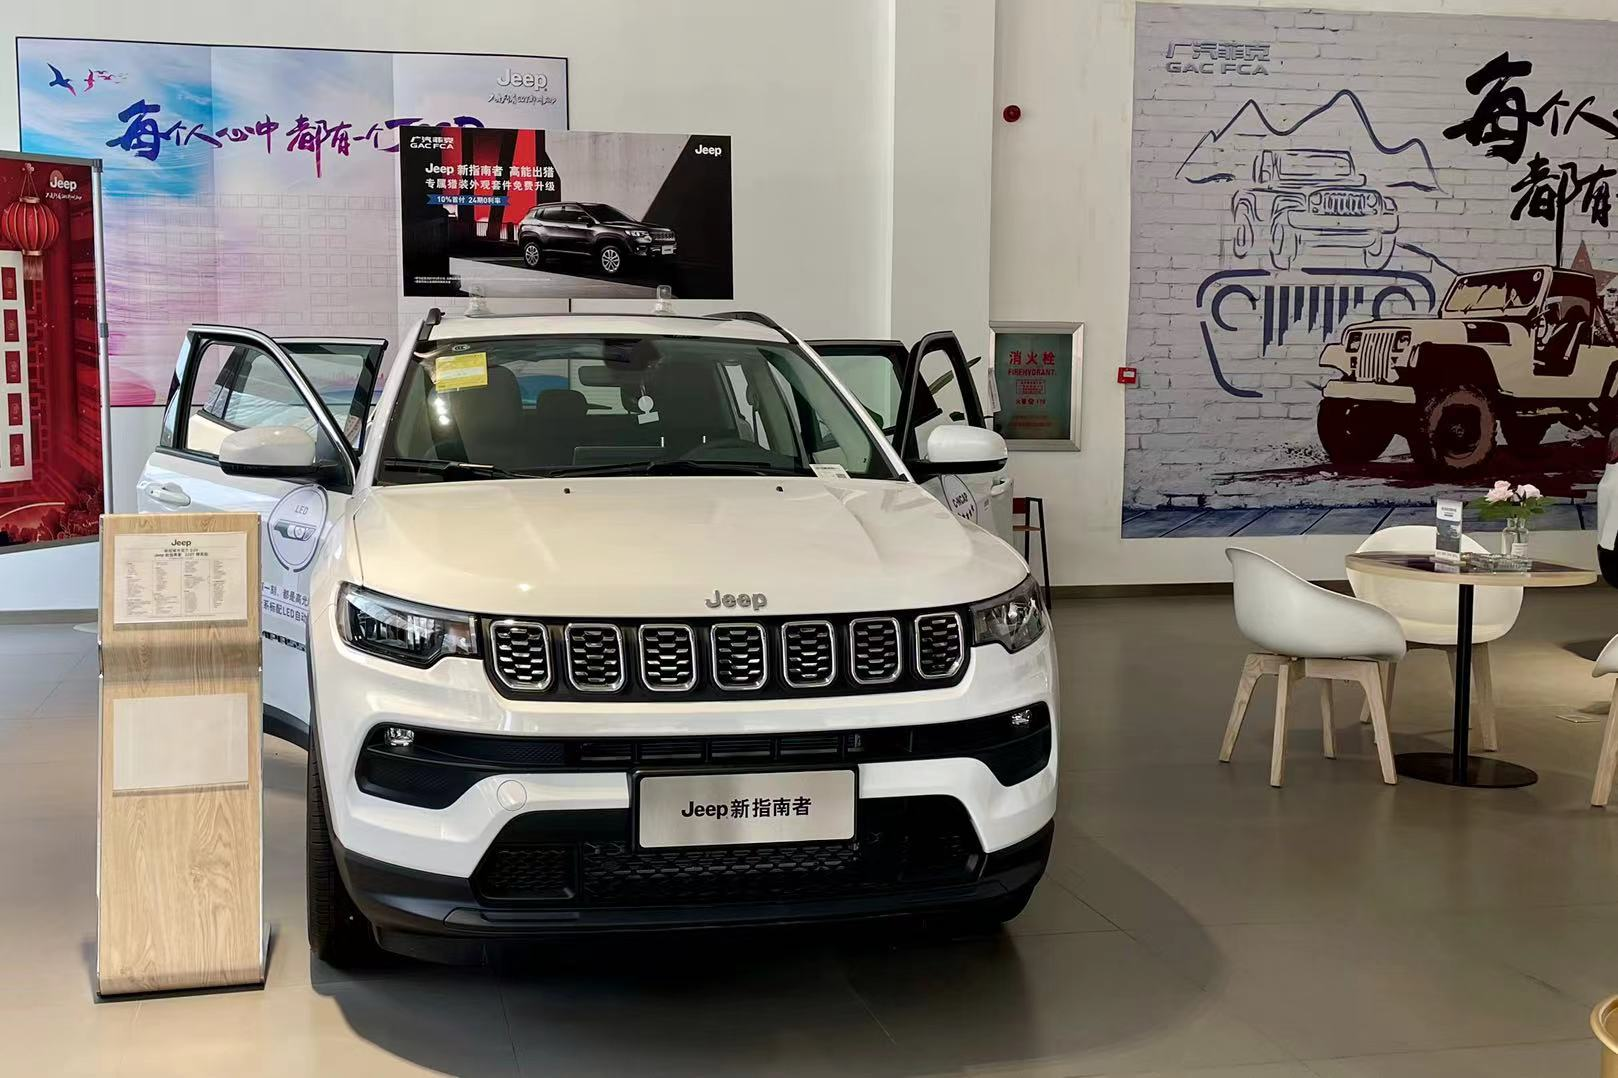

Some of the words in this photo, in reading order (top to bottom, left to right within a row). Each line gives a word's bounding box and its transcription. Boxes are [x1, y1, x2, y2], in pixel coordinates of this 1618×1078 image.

[1165, 40, 1271, 61] 广汽菲克
[1166, 62, 1214, 74] GAC
[1220, 63, 1269, 76] FCA
[497, 68, 548, 91] Jeep
[1443, 51, 1618, 165] 每个人
[694, 144, 723, 157] Jeep
[425, 163, 455, 176] Jeep
[457, 165, 504, 177] 新指南者
[509, 165, 555, 178] 高能出猎
[50, 176, 77, 191] Jeep
[425, 179, 556, 191] 专属猎装外观套件免费升级
[437, 196, 465, 204] 10%首付
[1510, 152, 1618, 268] 都有
[1009, 351, 1056, 366] 消火栓
[295, 504, 309, 515] LED
[171, 539, 192, 547] Jeep
[704, 589, 768, 611] Jeep
